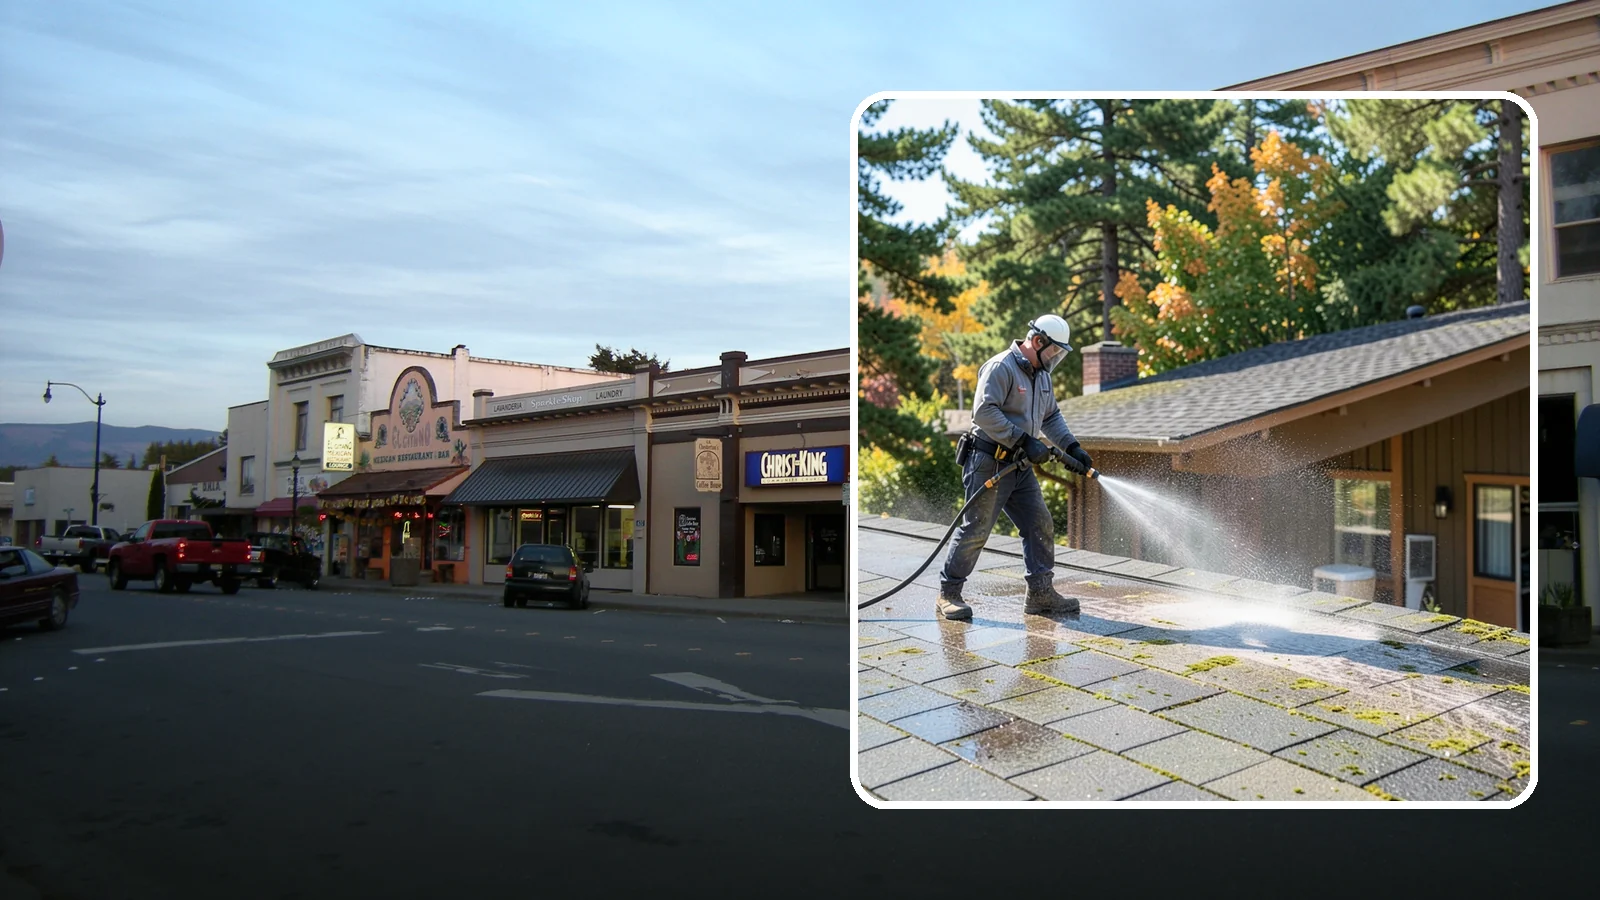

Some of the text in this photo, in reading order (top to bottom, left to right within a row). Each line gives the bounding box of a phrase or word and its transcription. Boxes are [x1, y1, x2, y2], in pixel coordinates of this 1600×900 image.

[530, 394, 582, 409] Sparkle Shop
[596, 389, 624, 400] LAUNDRY
[494, 402, 522, 412] LAVANDERIA
[374, 454, 396, 464] MEXICAN
[398, 451, 433, 462] RESTAURANT
[438, 450, 450, 458] BAR
[760, 452, 797, 478] CHRIST
